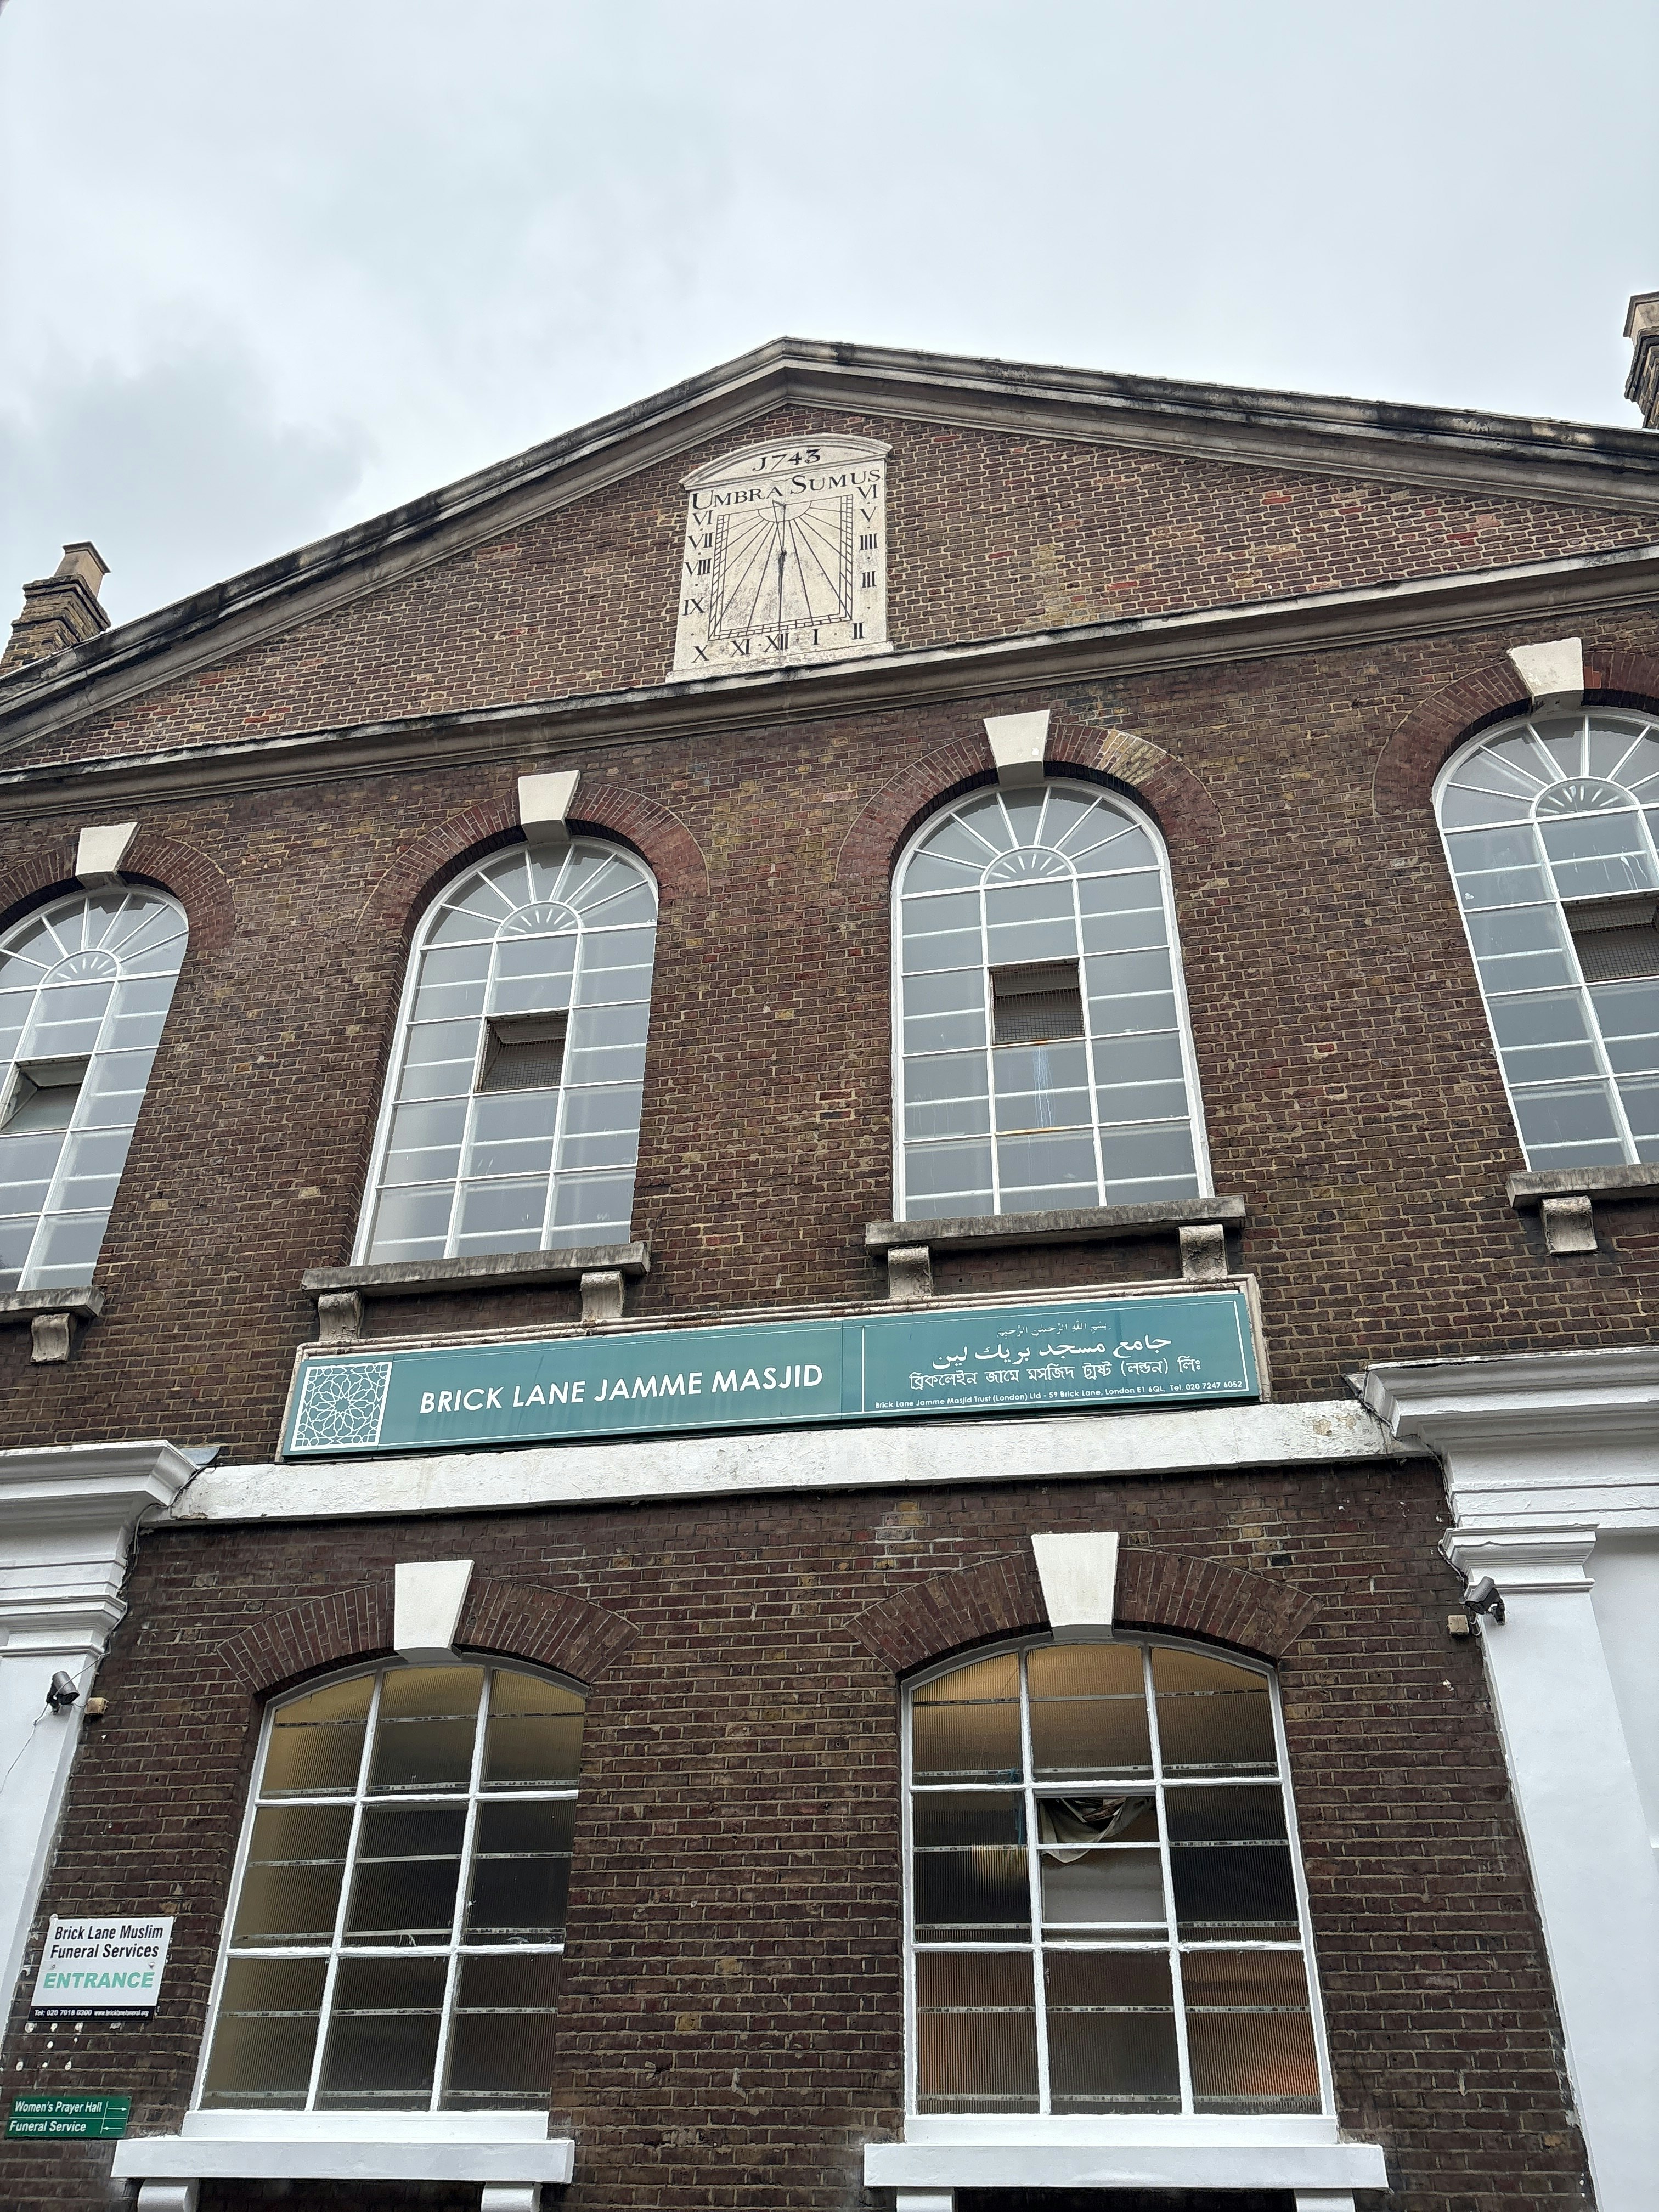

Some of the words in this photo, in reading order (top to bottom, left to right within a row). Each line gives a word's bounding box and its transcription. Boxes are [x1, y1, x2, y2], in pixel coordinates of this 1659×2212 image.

[692, 487, 783, 510] UMBRA
[857, 484, 878, 499] VI
[692, 510, 713, 526] VI
[861, 508, 878, 522] V
[687, 532, 713, 549] VII
[859, 533, 878, 551] IIII
[685, 558, 712, 576] VIII
[861, 571, 877, 588] III
[682, 597, 705, 616] IX
[692, 645, 709, 663] X
[731, 639, 751, 657] XI
[764, 633, 789, 653] XII
[851, 622, 865, 640] II
[975, 1343, 1030, 1364] بريك
[1039, 1343, 1106, 1359] مسجد
[1113, 1334, 1172, 1358] جامع
[933, 1346, 967, 1369] لين
[984, 1369, 1020, 1384] জামে
[1026, 1363, 1075, 1381] মসজিদ
[419, 1386, 503, 1414] BRICK
[512, 1381, 585, 1408] LANE
[594, 1372, 702, 1402] JAMME
[711, 1364, 822, 1394] MASJID
[946, 1396, 972, 1405] Masjid
[993, 1393, 1028, 1402] (London)
[1060, 1390, 1079, 1398] Brick
[1081, 1389, 1103, 1397] Lane,
[1105, 1387, 1135, 1396] London
[1148, 1385, 1166, 1393] 6QL,
[1201, 1381, 1221, 1390] 7247
[1223, 1380, 1243, 1389] 6052
[55, 1925, 84, 1940] Brick
[88, 1925, 116, 1939] Lane
[120, 1924, 163, 1939] Muslim
[50, 1944, 99, 1959] Funeral
[102, 1943, 159, 1958] Services
[43, 1972, 155, 1989] ENTRANCE
[15, 2101, 53, 2113] Women's
[55, 2101, 84, 2114] Prayer
[85, 2101, 103, 2113] Hall
[9, 2120, 47, 2132] Funeral
[49, 2120, 87, 2132] Service
